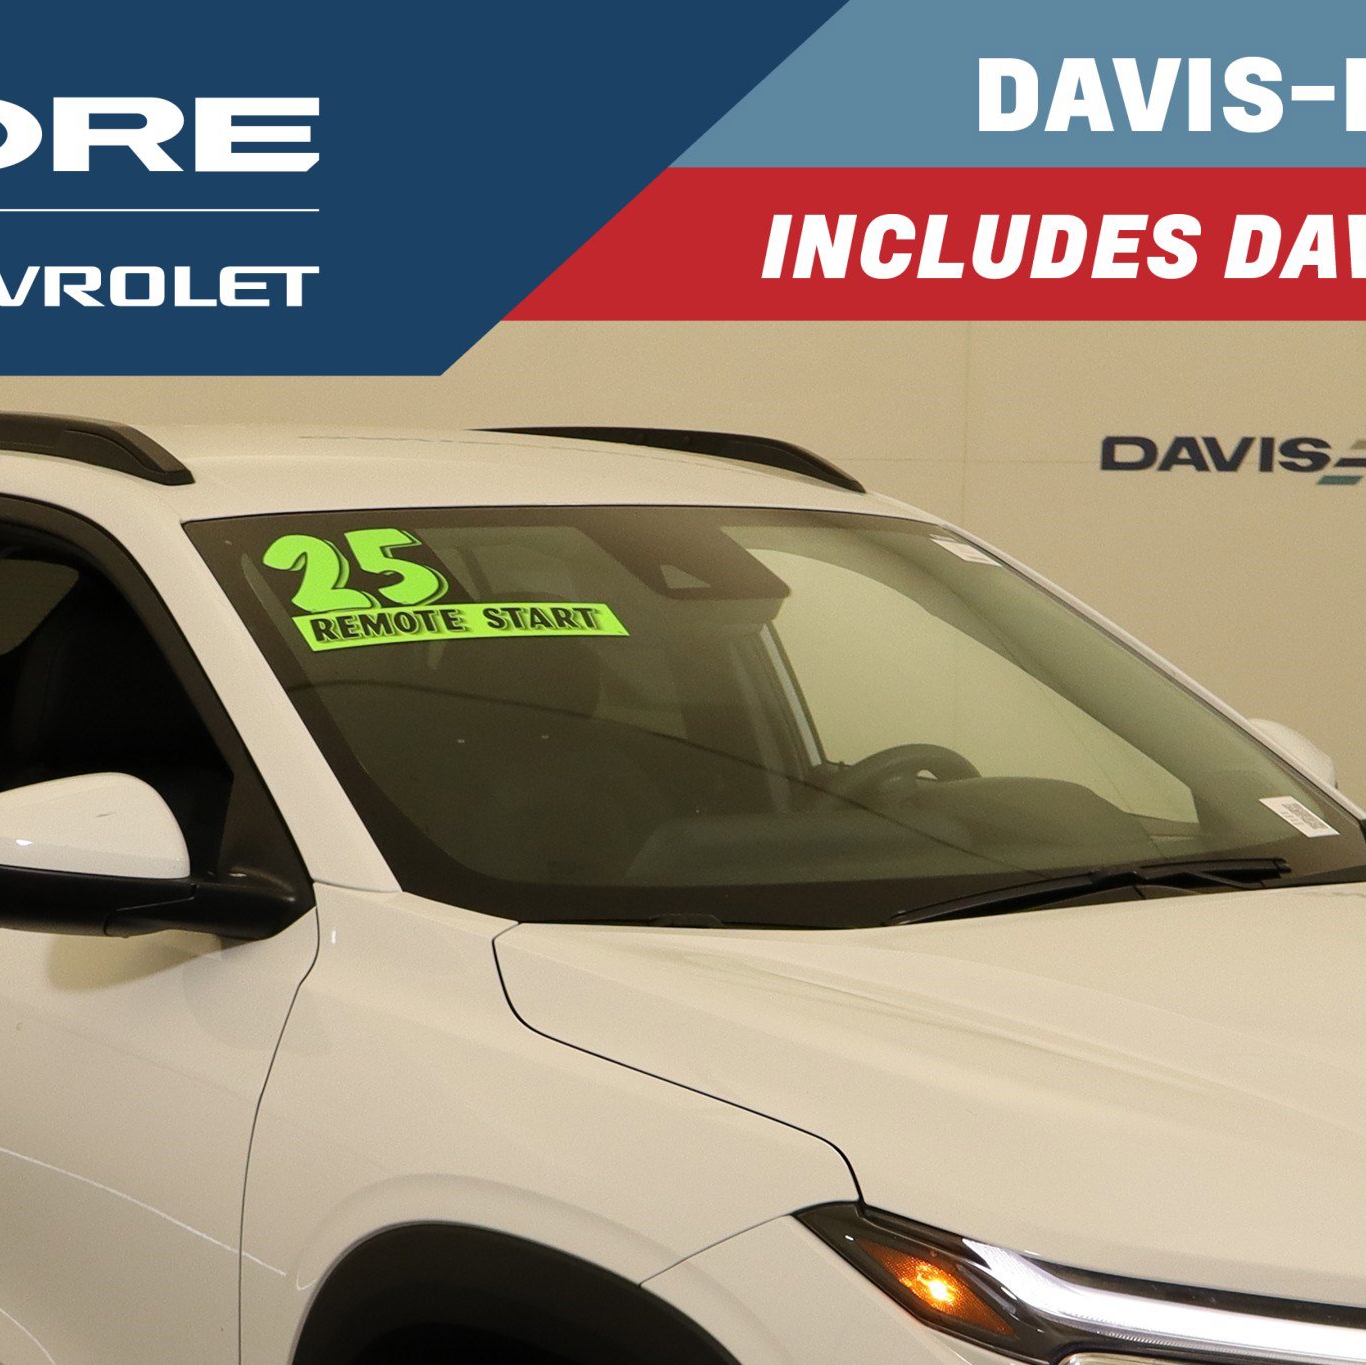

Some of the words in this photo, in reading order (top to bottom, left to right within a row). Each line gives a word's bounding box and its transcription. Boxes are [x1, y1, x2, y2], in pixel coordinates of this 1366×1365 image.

[1100, 436, 1332, 472] DAVIS
[263, 528, 449, 613] 25
[310, 609, 468, 642] REMOTE
[487, 607, 600, 630] START
